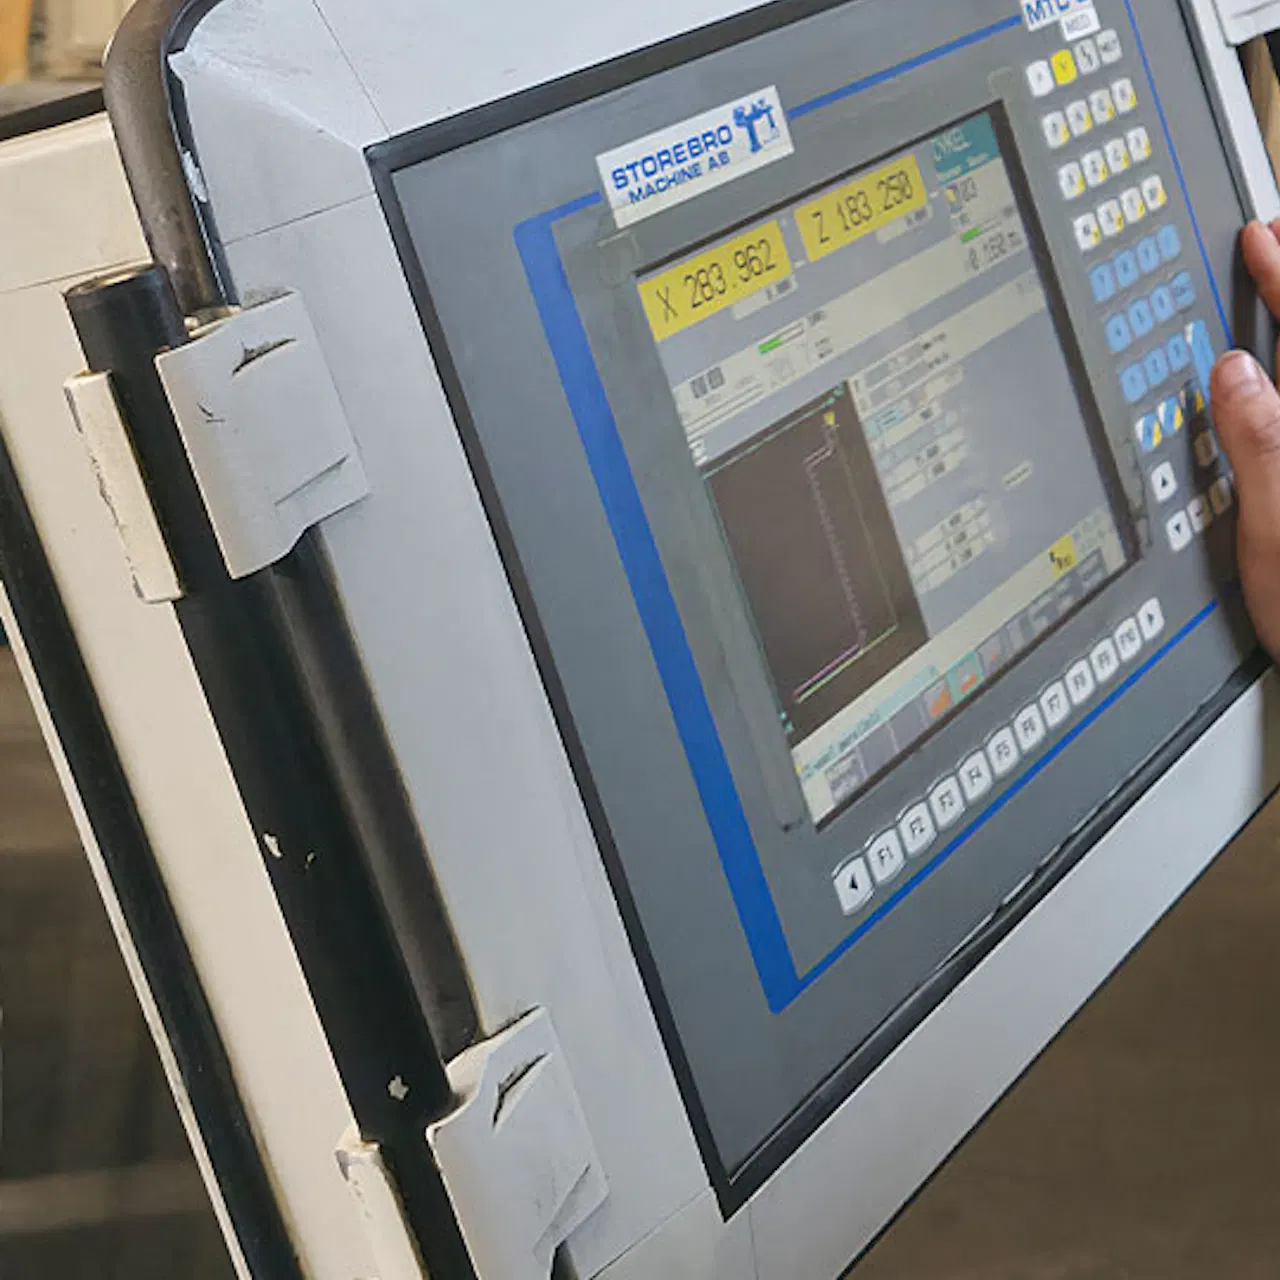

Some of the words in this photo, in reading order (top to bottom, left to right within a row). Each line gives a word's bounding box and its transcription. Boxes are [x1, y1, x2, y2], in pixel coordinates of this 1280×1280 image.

[612, 125, 733, 190] STOREBRO
[628, 162, 702, 204] MACHINE
[708, 151, 731, 171] AB
[812, 211, 831, 243] Z
[656, 286, 678, 324] X
[684, 238, 777, 308] 283.962
[877, 846, 894, 867] F1
